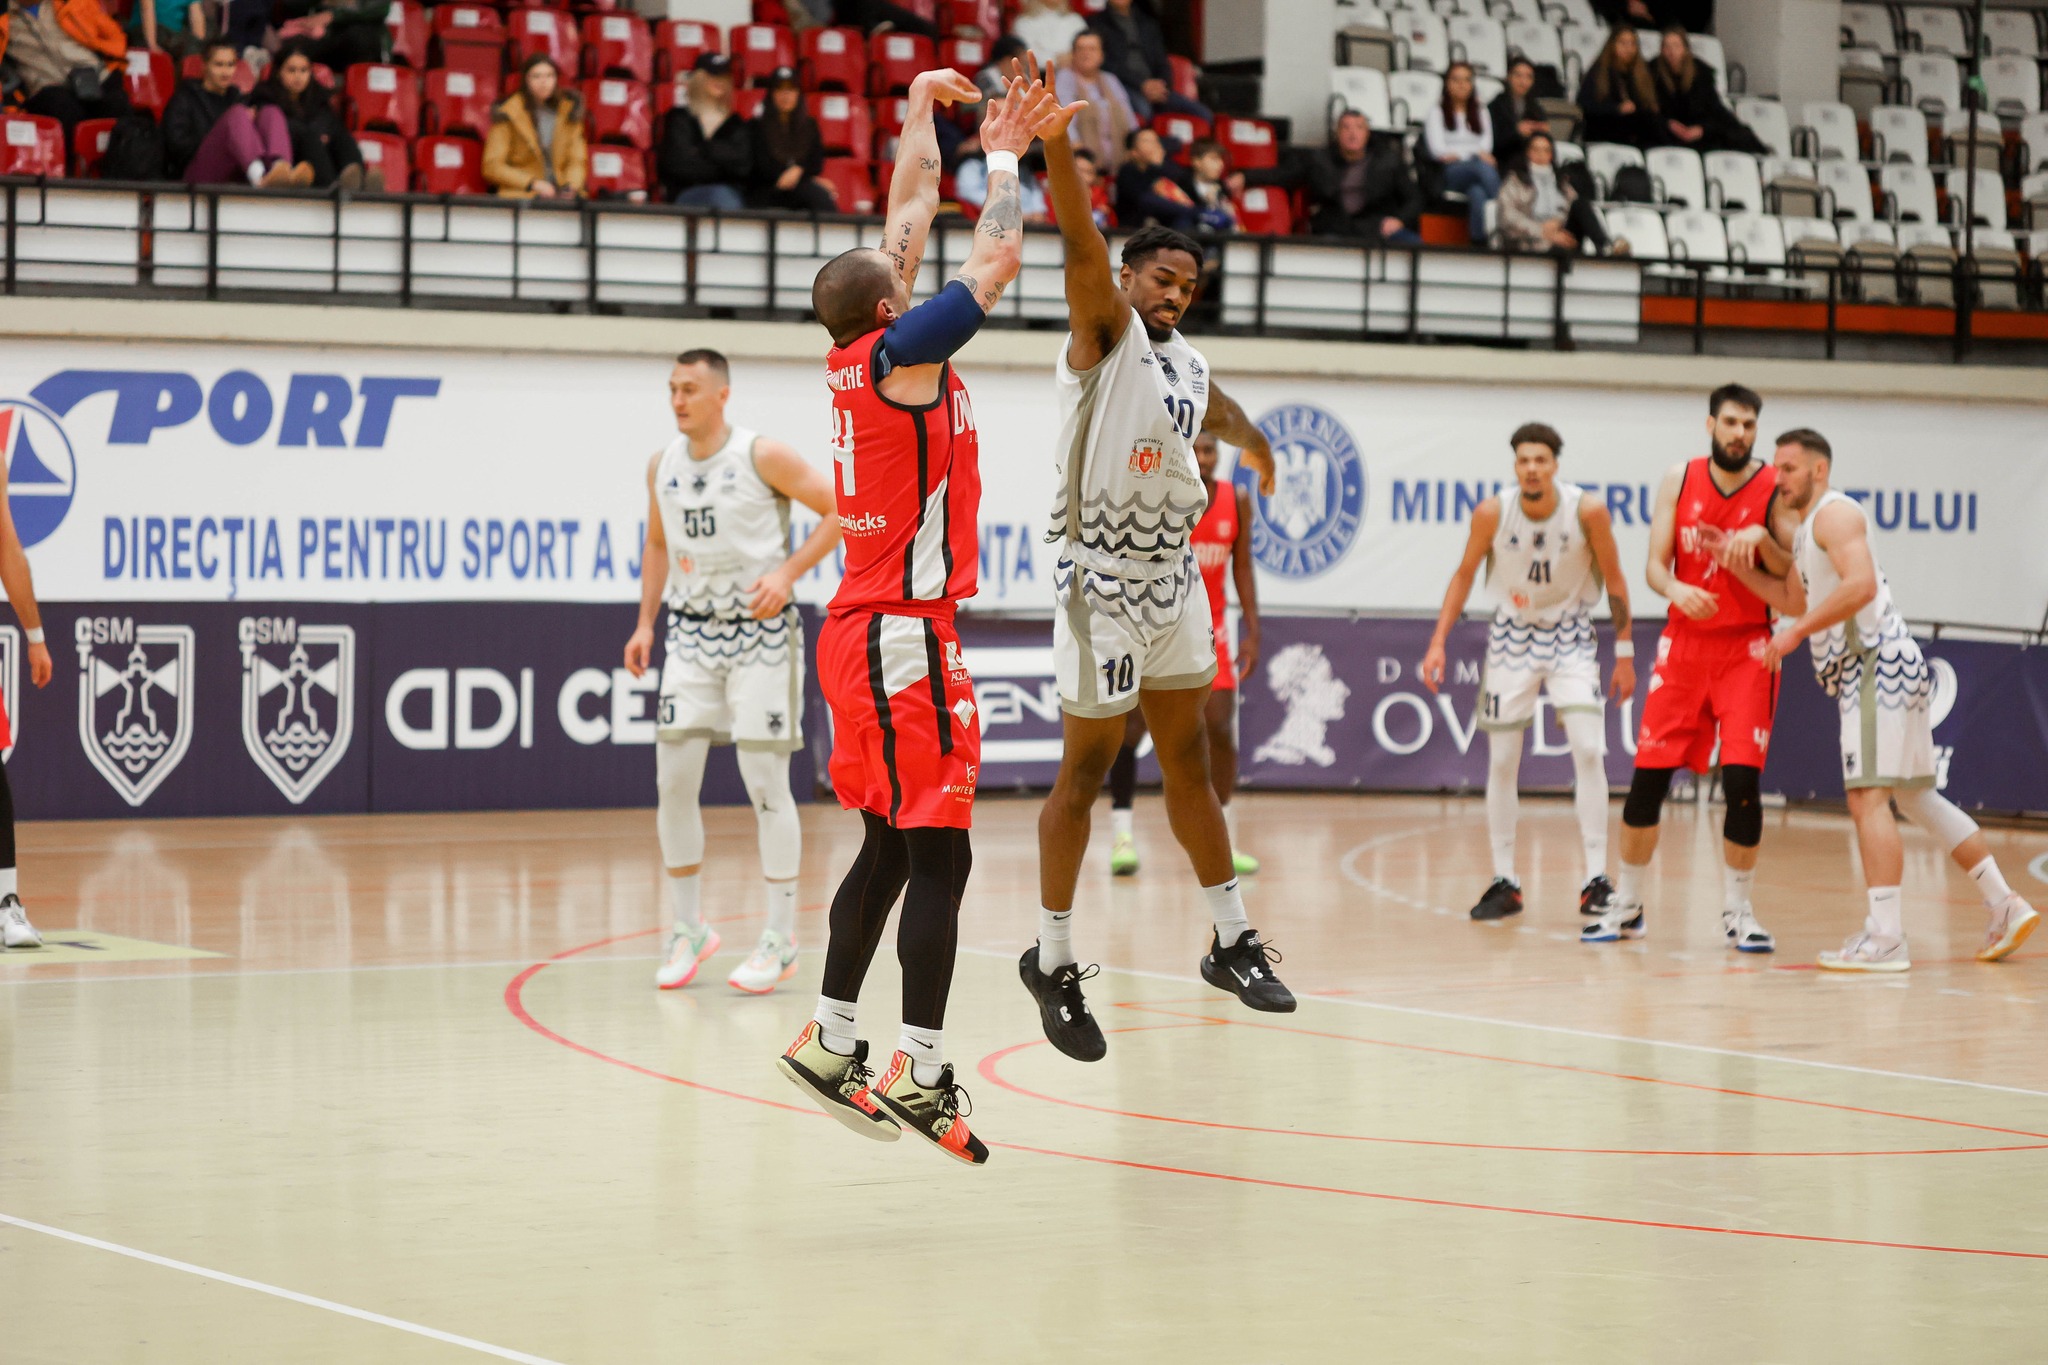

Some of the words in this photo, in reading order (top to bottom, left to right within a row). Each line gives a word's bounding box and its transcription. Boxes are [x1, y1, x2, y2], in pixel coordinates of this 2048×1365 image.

[684, 506, 717, 539] 55
[300, 517, 447, 579] PENTRU
[462, 518, 580, 580] SPORT
[593, 519, 615, 580] A
[1528, 558, 1551, 585] 41
[75, 616, 134, 645] CSM
[238, 616, 296, 645] CSM
[1101, 651, 1135, 697] 10
[941, 783, 976, 796] MONTEB
